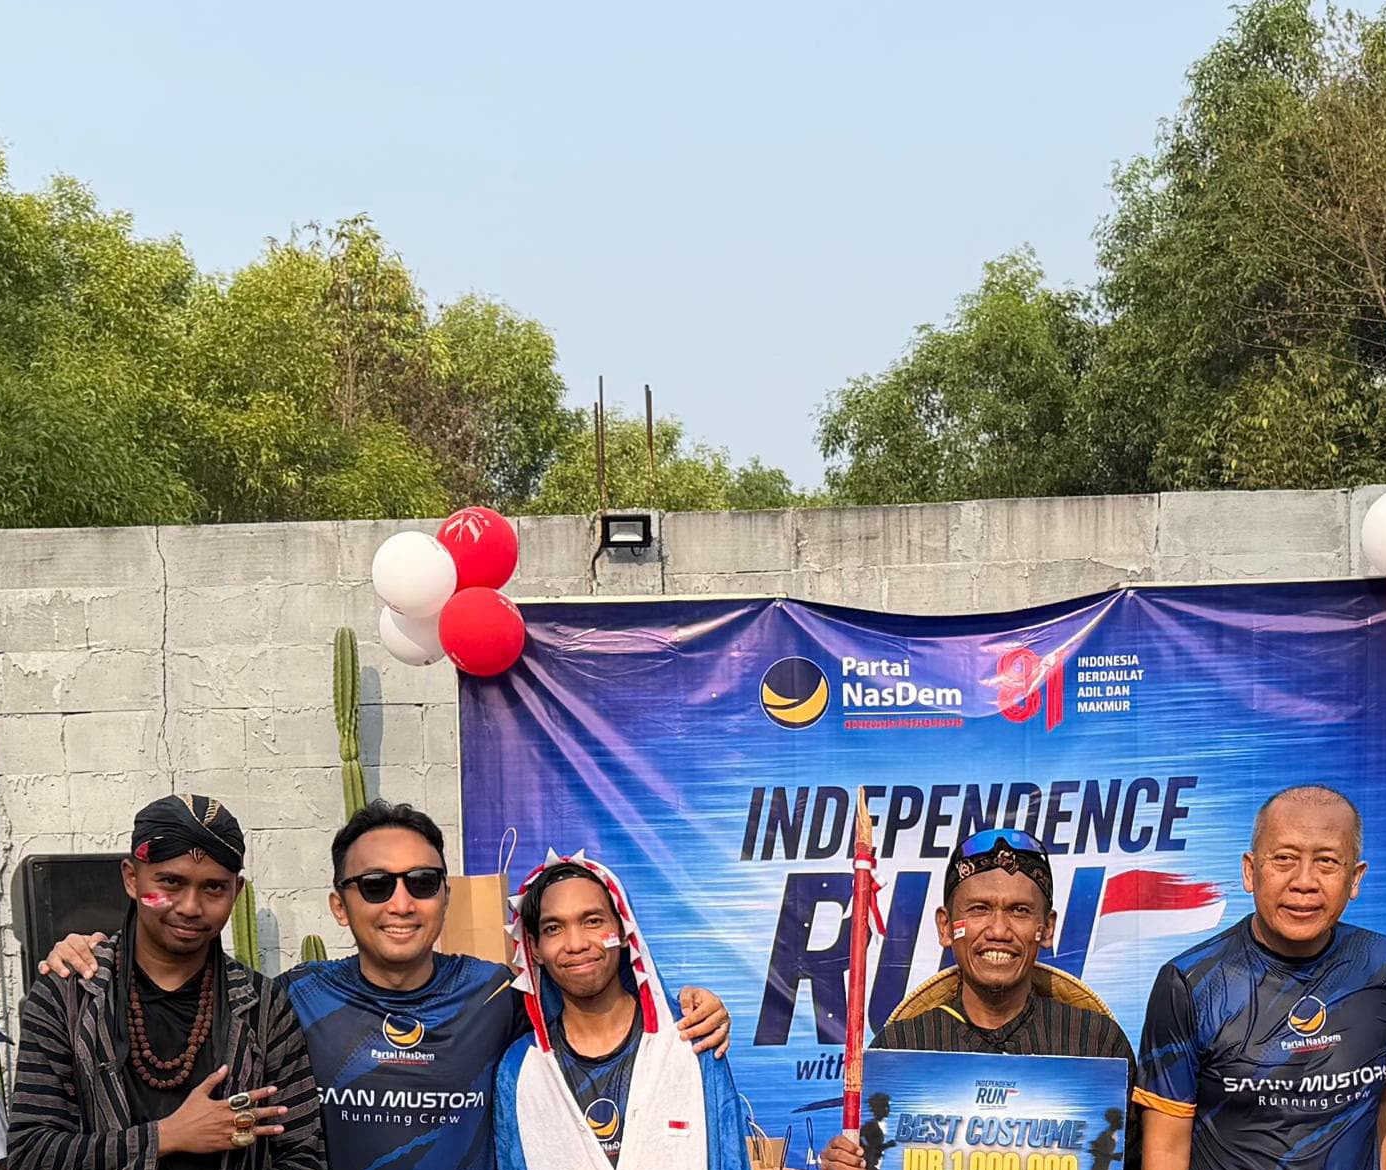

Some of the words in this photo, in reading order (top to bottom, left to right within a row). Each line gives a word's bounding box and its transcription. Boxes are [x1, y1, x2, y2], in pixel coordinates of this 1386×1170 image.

[841, 657, 910, 677] Partai
[1077, 655, 1140, 667] INDONESIA
[1077, 669, 1145, 682] BERDAULAT
[842, 681, 963, 707] NasDem
[1077, 684, 1104, 698] ADIL
[1105, 684, 1131, 697] DAN
[1077, 700, 1131, 713] MAKMUR
[1306, 1033, 1342, 1048] NasDem
[399, 1051, 435, 1061] NasDem
[317, 1087, 375, 1107] SAAN
[381, 1090, 484, 1109] MUSTOPA
[975, 1087, 1008, 1104] RUN
[1258, 1094, 1329, 1109] Running
[341, 1110, 412, 1126] Running
[419, 1113, 461, 1124] Crew
[895, 1113, 963, 1145] BEST
[965, 1115, 1088, 1150] COSTUME
